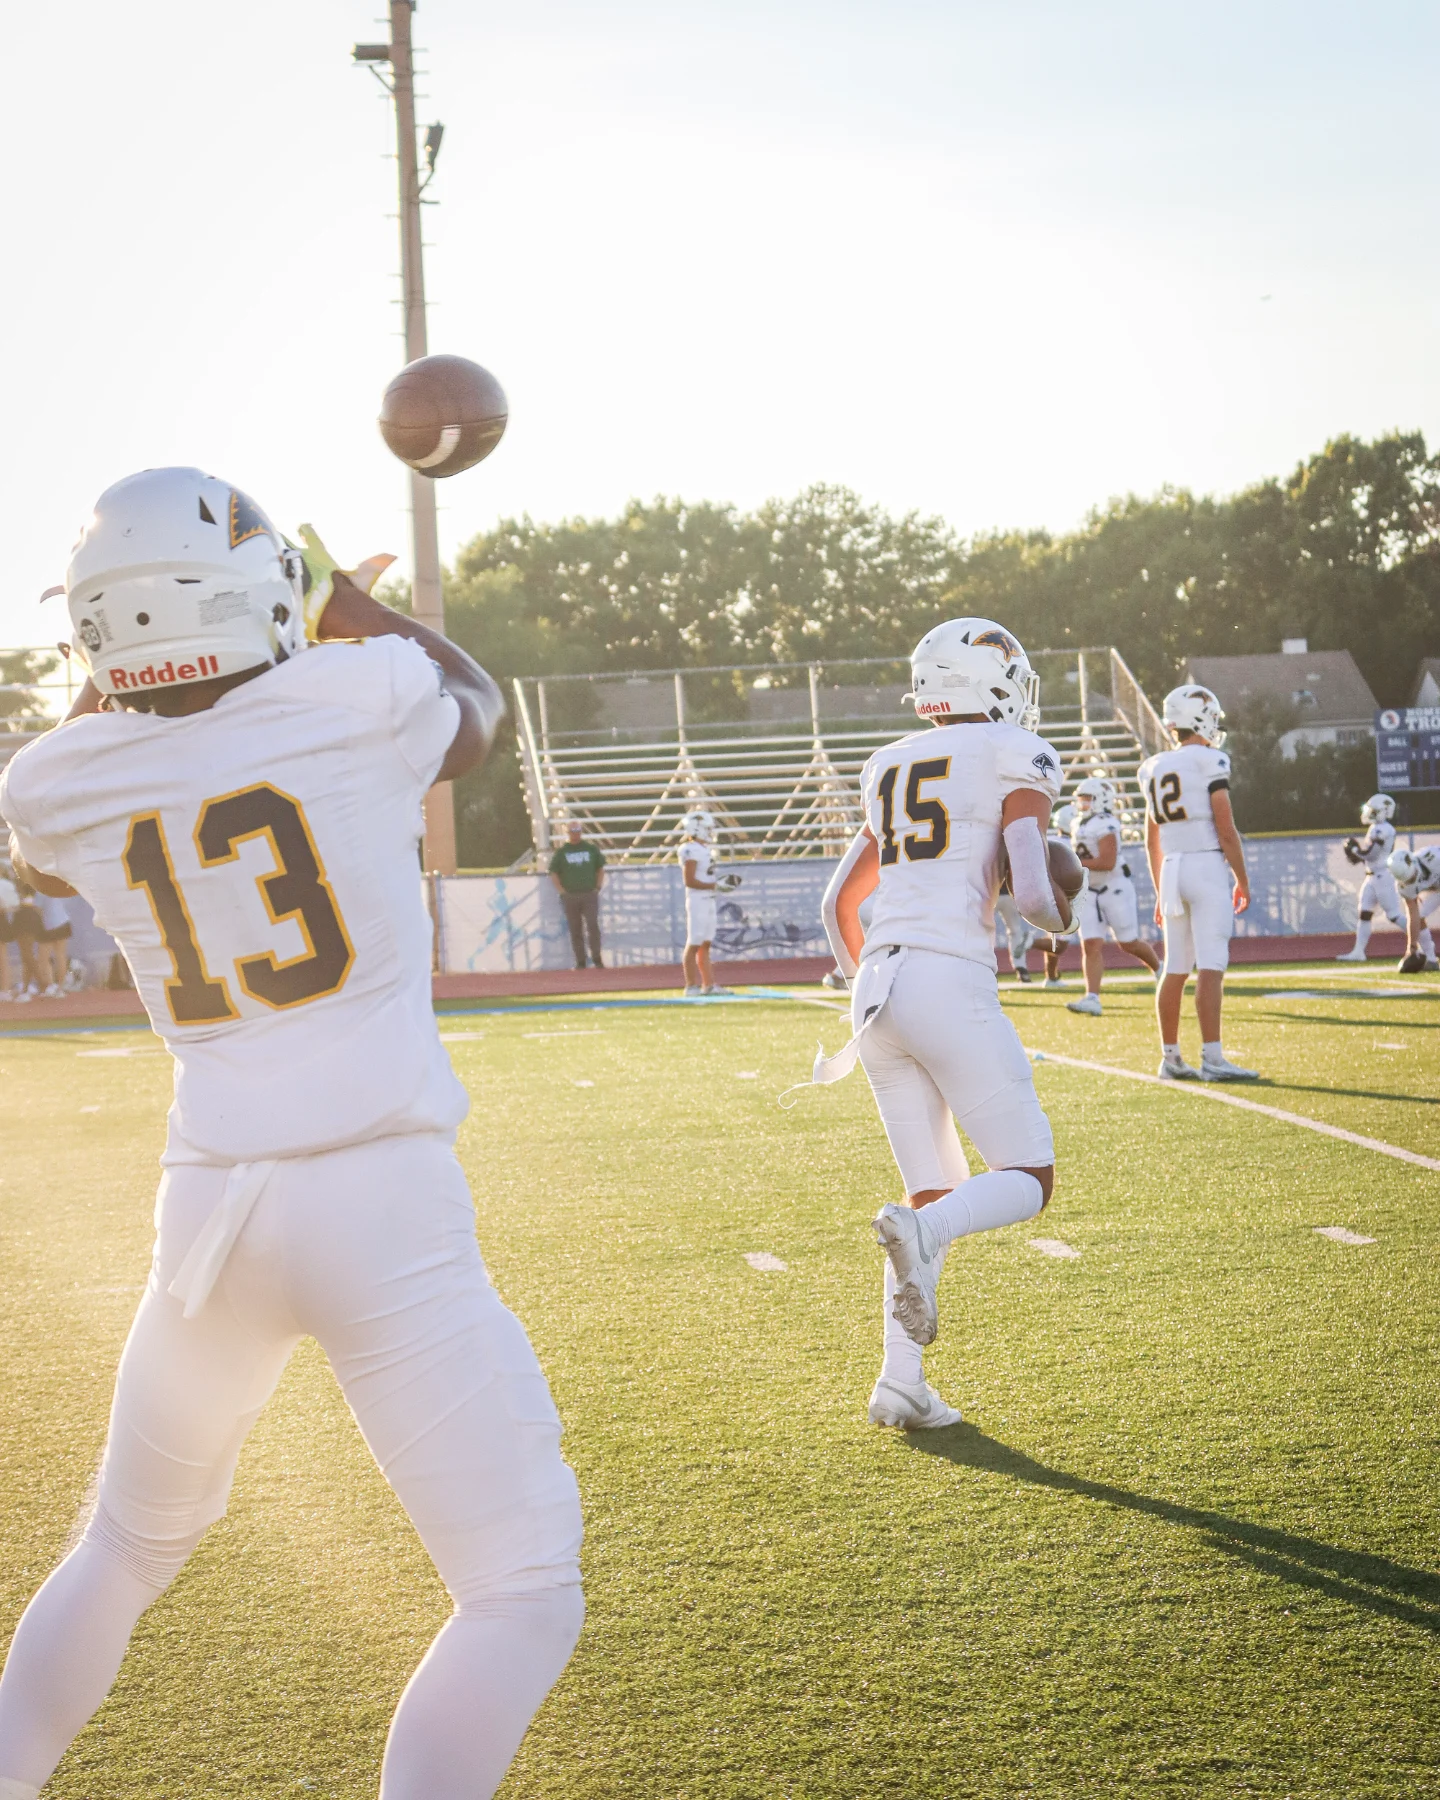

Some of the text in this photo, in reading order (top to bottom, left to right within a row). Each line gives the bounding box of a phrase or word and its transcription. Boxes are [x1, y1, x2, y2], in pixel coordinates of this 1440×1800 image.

[109, 655, 219, 690] Riddell
[877, 755, 953, 867] 15
[1149, 772, 1188, 825] 12
[120, 780, 357, 1026] 13
